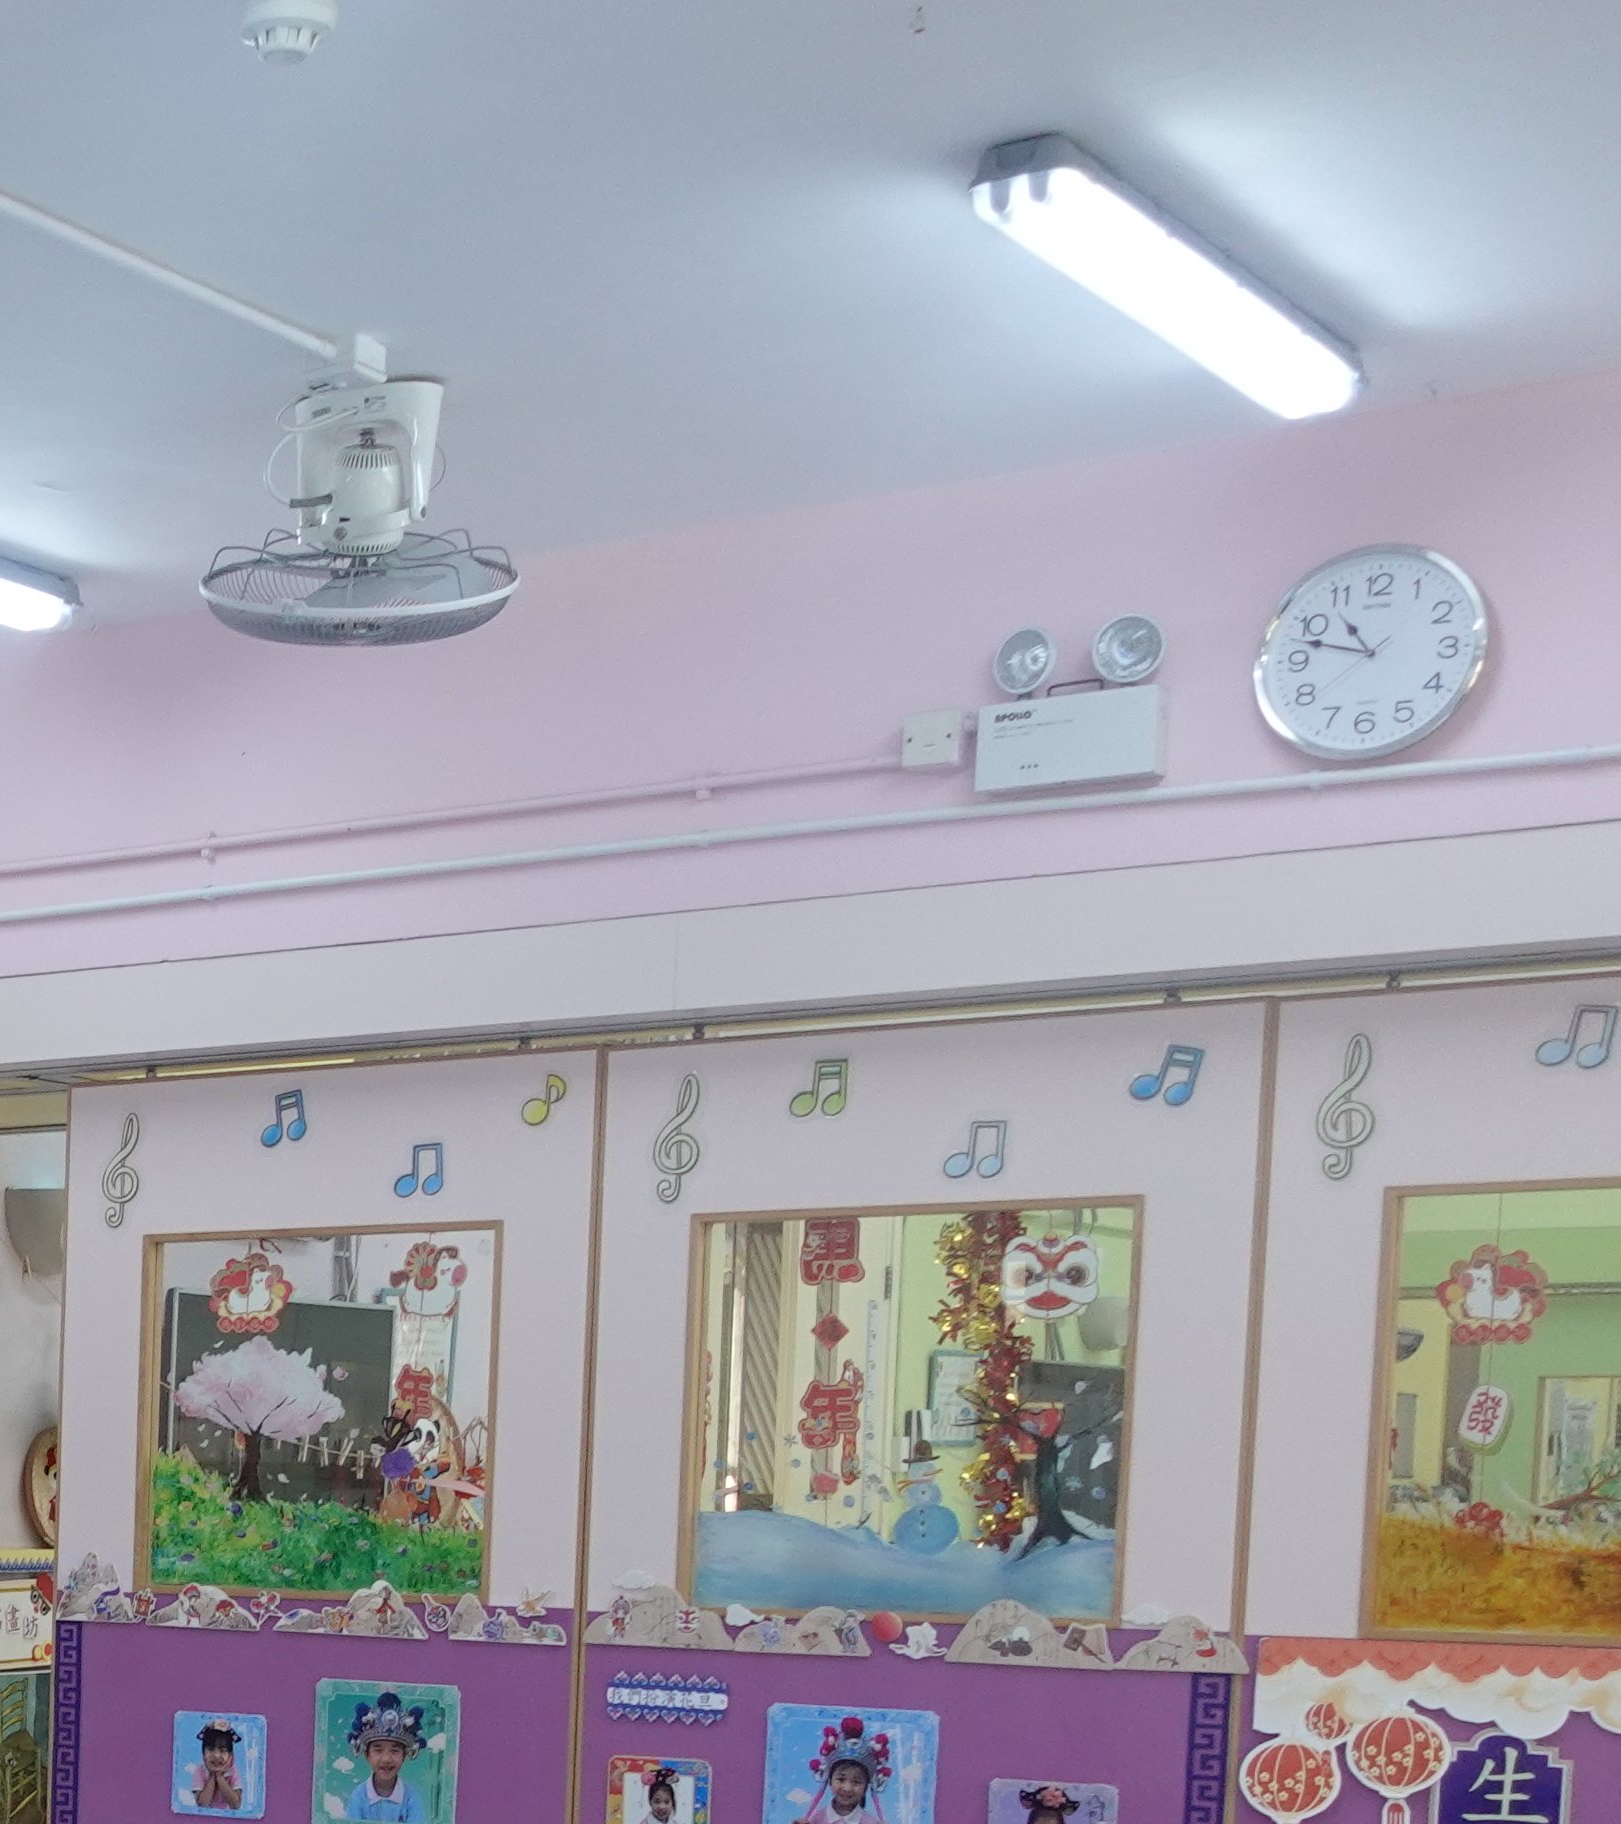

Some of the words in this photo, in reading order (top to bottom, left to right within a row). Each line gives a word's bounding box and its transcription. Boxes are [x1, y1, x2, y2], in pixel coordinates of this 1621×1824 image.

[1330, 585, 1353, 607] 11
[1366, 573, 1394, 597] 12
[1412, 579, 1422, 599] 1
[1431, 602, 1454, 625] 2
[1300, 614, 1329, 636] 10
[1438, 636, 1458, 659] 3
[1288, 650, 1309, 673] 9
[1423, 672, 1445, 694] 4
[1296, 684, 1317, 706] 8
[995, 711, 1033, 723] APOLLO
[1321, 707, 1341, 728] 7
[1354, 712, 1375, 734] 6
[1394, 700, 1415, 724] 5
[1460, 1746, 1550, 1824] 生
